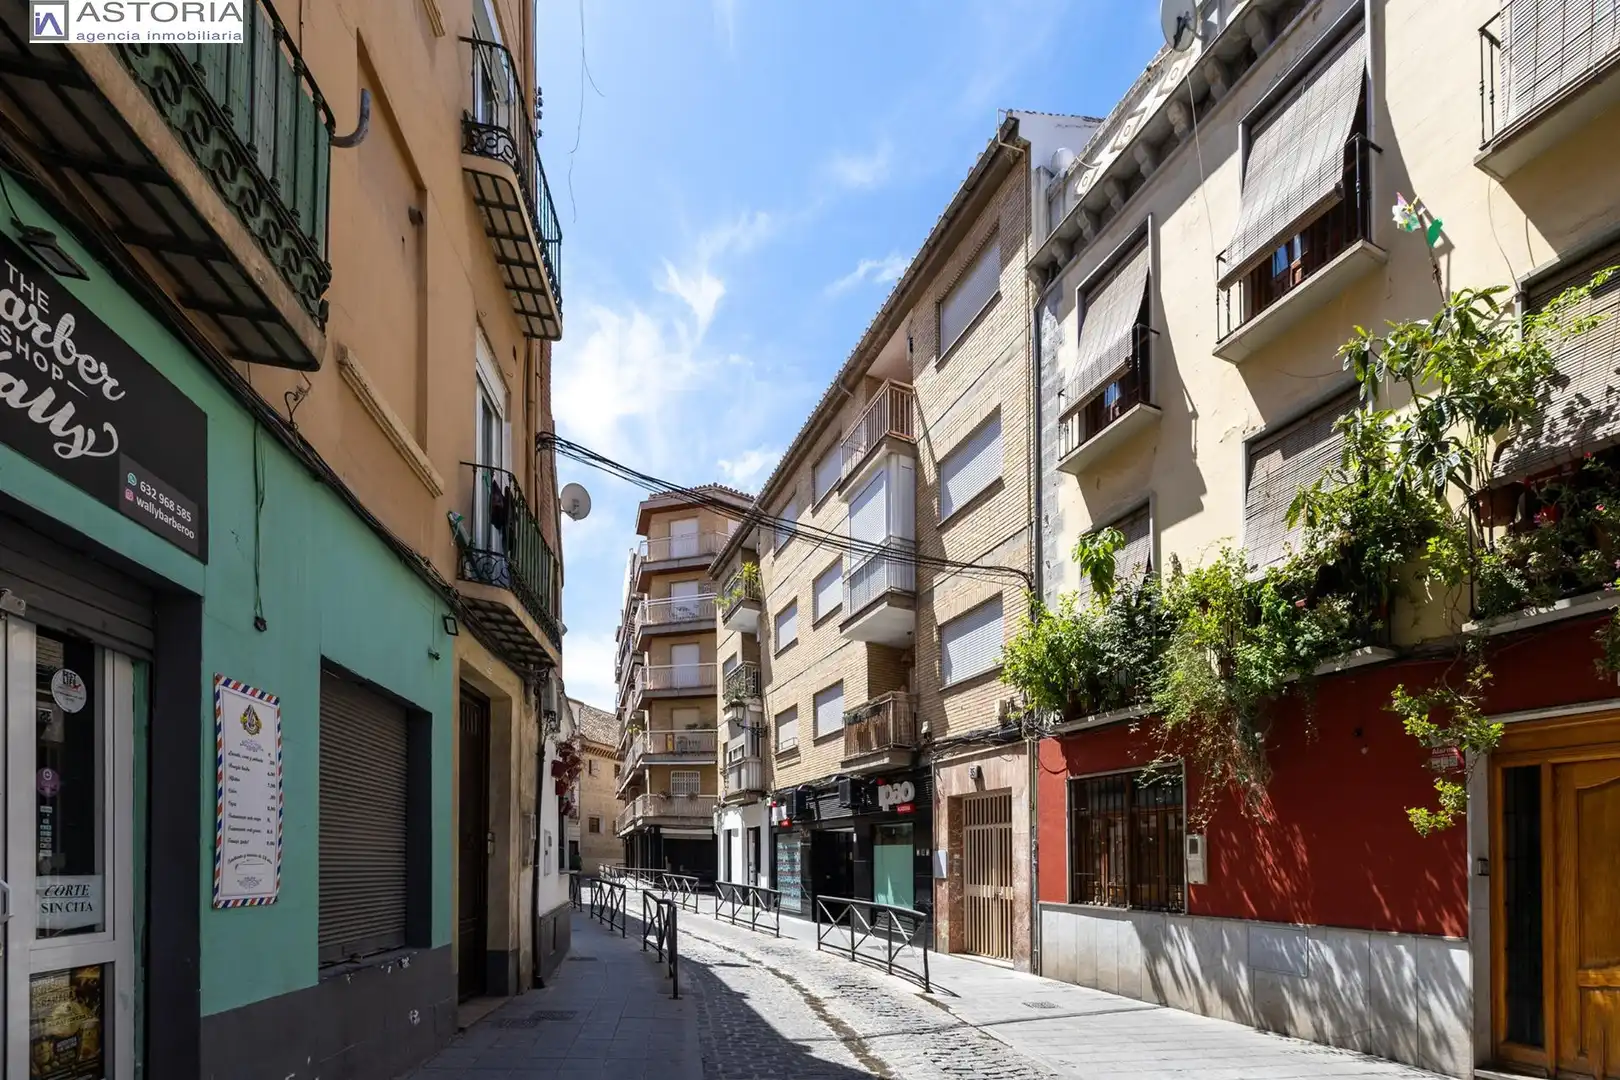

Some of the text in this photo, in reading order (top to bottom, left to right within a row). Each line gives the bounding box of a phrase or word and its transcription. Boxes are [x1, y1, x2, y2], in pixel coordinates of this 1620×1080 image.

[4, 259, 49, 314] THE
[0, 288, 126, 400] arber
[0, 324, 64, 381] SHOP
[0, 351, 119, 459] ally
[136, 496, 195, 539] wallybarberoo
[140, 481, 192, 522] 632 968 585
[40, 901, 93, 914] SIN CITA
[44, 883, 91, 897] CORTE
